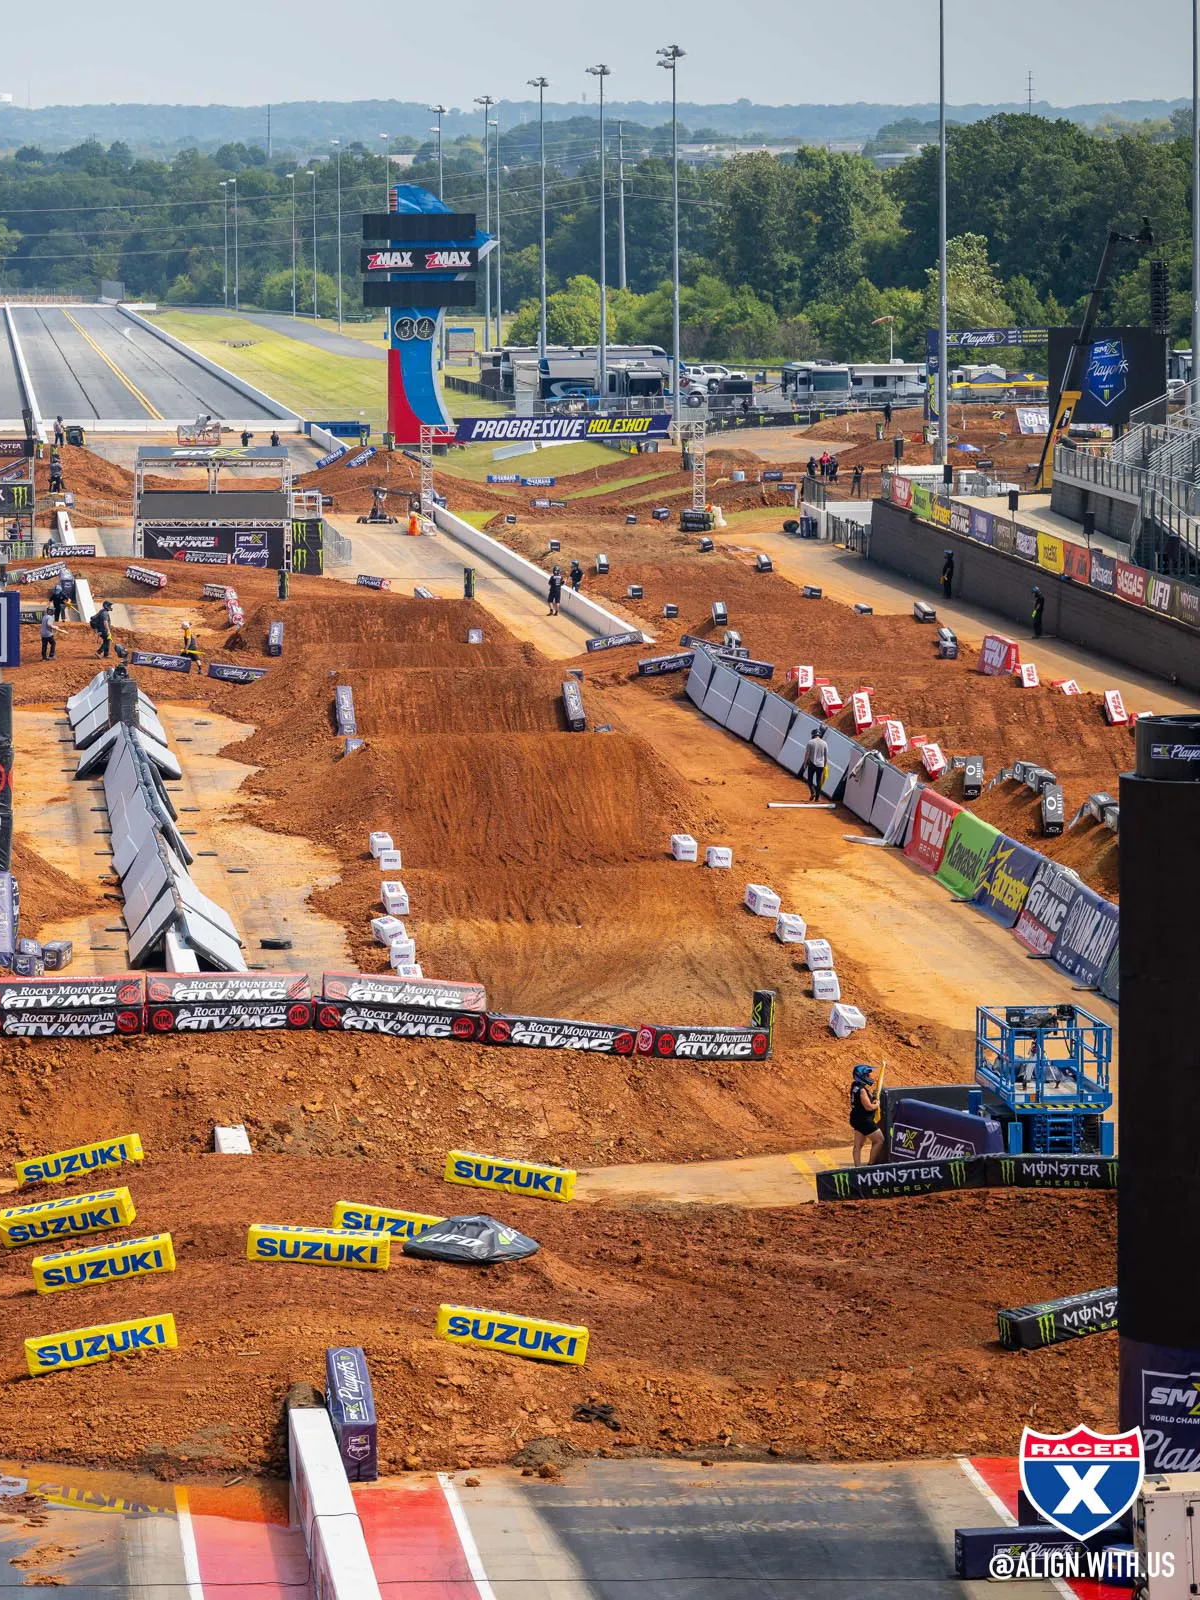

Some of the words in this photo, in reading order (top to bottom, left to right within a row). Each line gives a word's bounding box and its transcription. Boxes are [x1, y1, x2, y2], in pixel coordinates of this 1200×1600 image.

[400, 319, 411, 338] 3
[419, 319, 430, 338] 4
[960, 333, 995, 346] Playoffs
[1094, 341, 1119, 355] SMX
[471, 419, 584, 439] PROGRESSIVE
[587, 417, 653, 434] HOLESHOT
[238, 534, 264, 544] SMX
[232, 547, 270, 561] Playoffs
[1151, 580, 1171, 610] UFO
[1171, 745, 1200, 762] Playo
[1069, 902, 1118, 968] YAMAHA
[1056, 950, 1094, 984] RACING
[20, 986, 57, 996] ROCKY
[59, 984, 117, 994] MOUNTAIN
[190, 980, 227, 990] ROCKY
[229, 979, 288, 989] MOUNTAIN
[367, 983, 401, 994] ROCKY
[402, 985, 461, 998] MOUNTAIN
[22, 1013, 58, 1022] ROCKY
[60, 1012, 115, 1021] MOUNTAIN
[192, 1007, 227, 1017] ROCKY
[229, 1005, 287, 1015] MOUNTAIN
[359, 1008, 392, 1020] ROCKY
[394, 1011, 452, 1024] MOUNTAIN
[527, 1024, 558, 1035] ROCKY
[560, 1027, 614, 1039] MOUNTAIN
[689, 1032, 713, 1042] ROCKY
[714, 1033, 752, 1042] MOUNTAIN
[24, 1144, 127, 1183] SUZUKI
[1022, 1162, 1101, 1178] MONSTER
[454, 1160, 563, 1194] SUZUKI
[857, 1165, 943, 1185] MONSTER
[1035, 1179, 1090, 1187] ENERGY
[872, 1183, 932, 1195] ENERGY
[5, 1190, 117, 1218] SUZUKI
[8, 1207, 119, 1243] SUZUKI
[260, 1225, 380, 1238] SUZUKI
[342, 1211, 436, 1240] SUZU
[41, 1234, 160, 1262] SUZUKI
[429, 1232, 486, 1248] UFO
[256, 1237, 378, 1264] SUZUKI
[43, 1249, 163, 1287] SUZUKI
[1062, 1299, 1118, 1328] MONS
[1077, 1319, 1118, 1335] ENER
[38, 1323, 165, 1367] SUZUKI
[448, 1316, 577, 1357] SUZUKI
[338, 1360, 364, 1401] Playoffs
